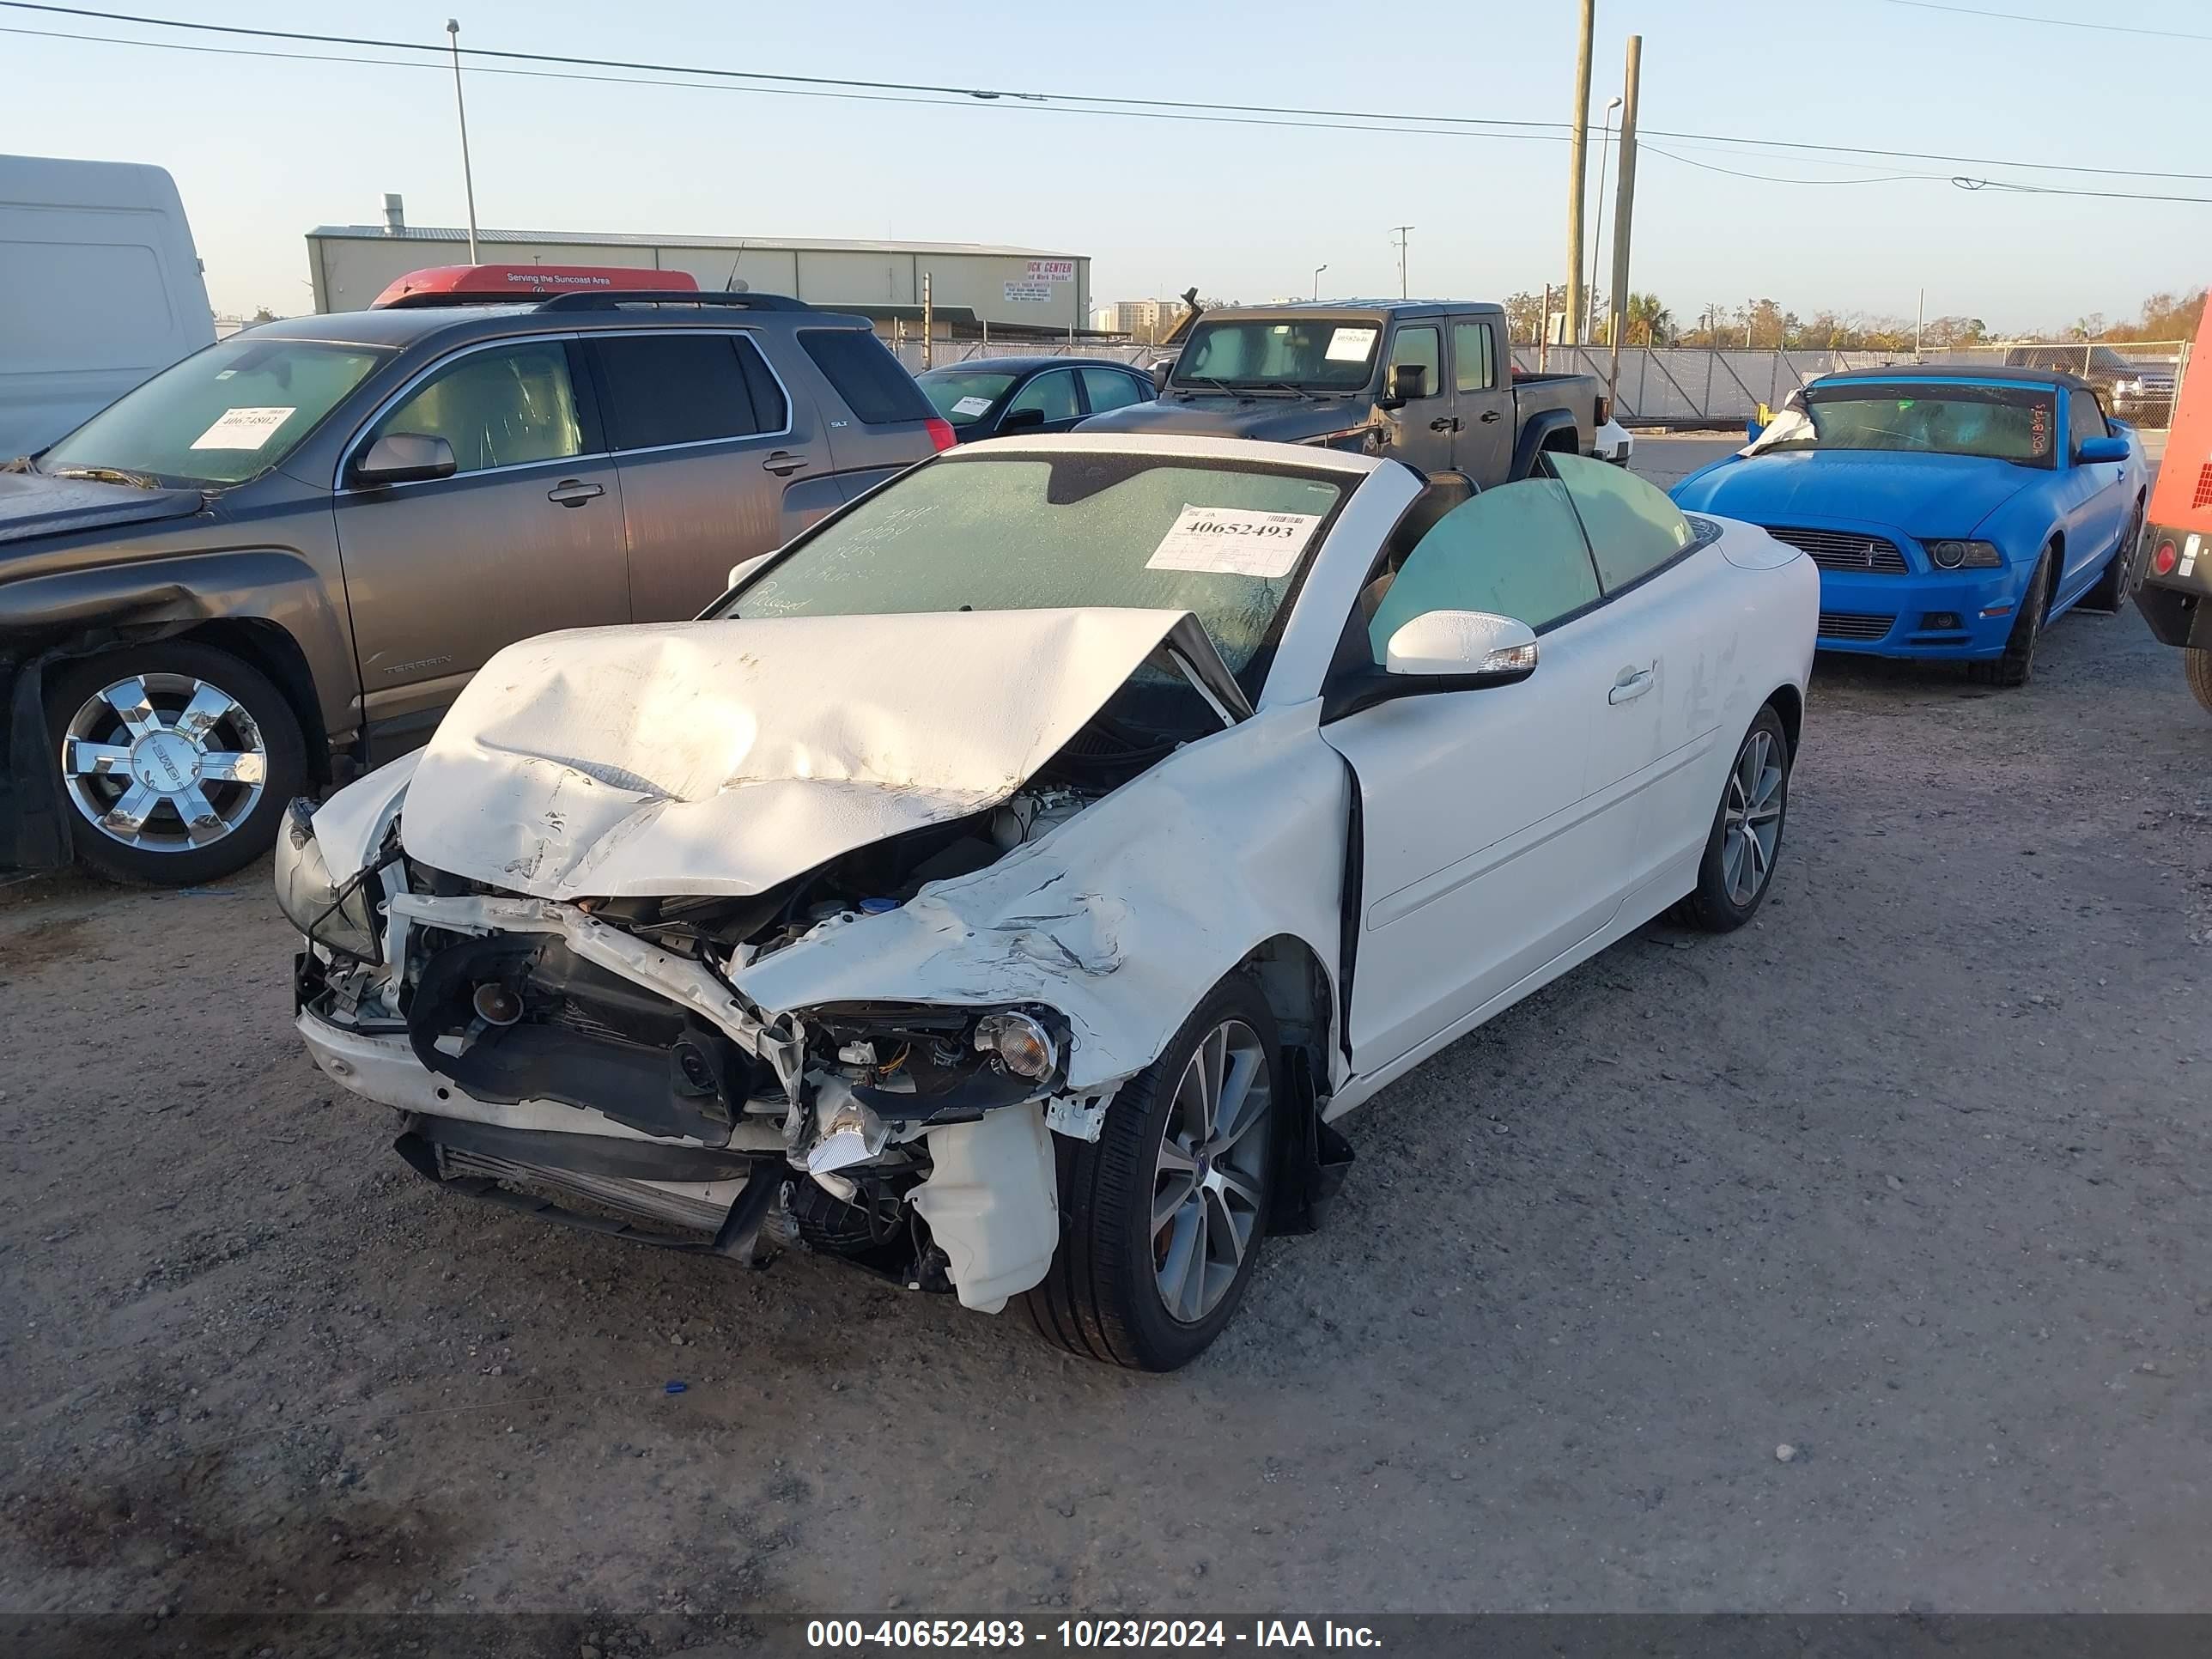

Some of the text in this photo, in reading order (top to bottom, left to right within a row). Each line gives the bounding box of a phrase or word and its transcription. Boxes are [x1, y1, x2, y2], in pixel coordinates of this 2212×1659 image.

[1044, 262, 1072, 273] CENTER
[507, 273, 611, 285] Serving the Suncoast Area
[222, 416, 277, 425] 40674802
[1186, 521, 1294, 538] 40652493
[384, 654, 453, 674] TERRAIN
[152, 744, 181, 781] GMC
